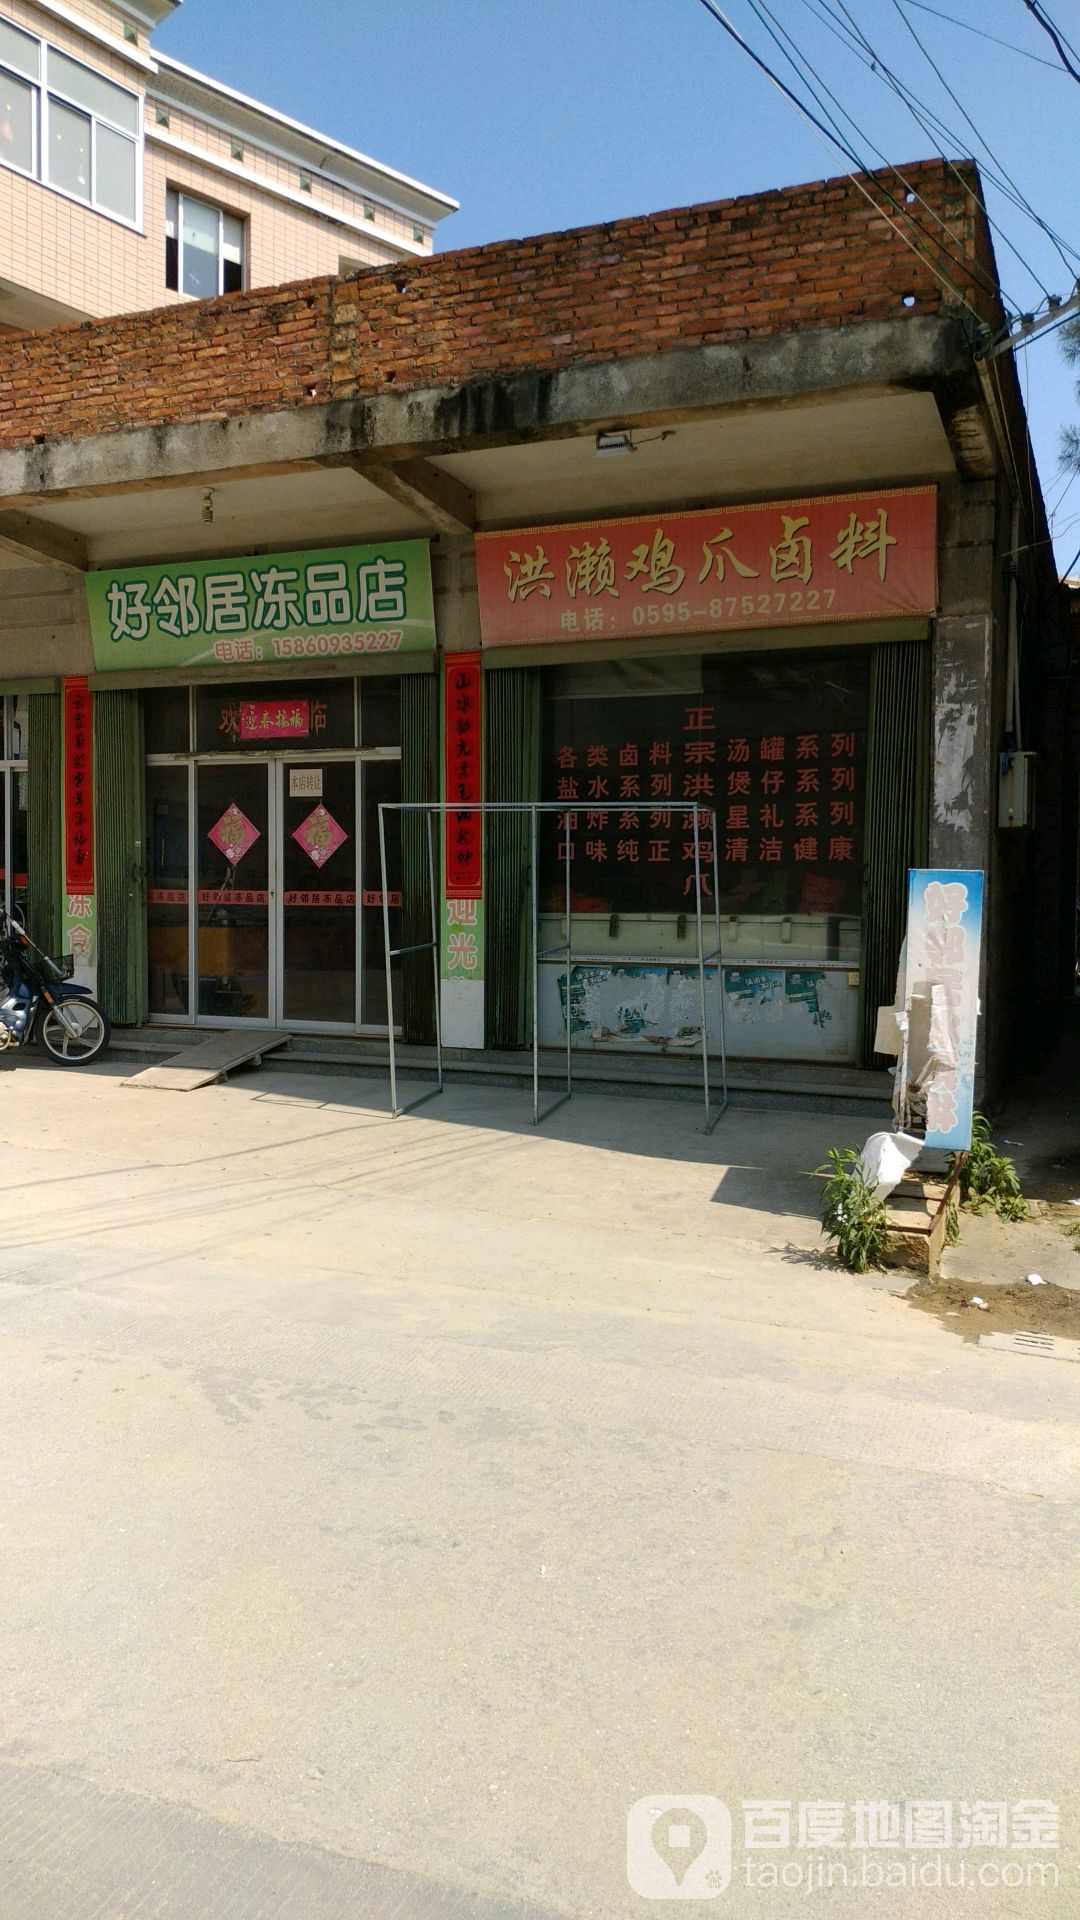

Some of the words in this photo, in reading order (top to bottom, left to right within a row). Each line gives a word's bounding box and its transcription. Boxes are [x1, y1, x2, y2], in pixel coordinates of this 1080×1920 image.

[504, 508, 898, 601] 洪濑鸡爪卤料
[107, 557, 407, 641] 好邻居冻品店
[557, 741, 673, 769] 各类卤料
[726, 732, 855, 762] 汤罐系列
[557, 773, 673, 799] 盐水系列
[727, 767, 855, 796] 煲仔系列
[557, 839, 671, 862] 口味纯正
[725, 836, 853, 862] 清洁健康
[151, 892, 187, 903] 冻品店
[288, 893, 355, 905] 好邻居冻品店
